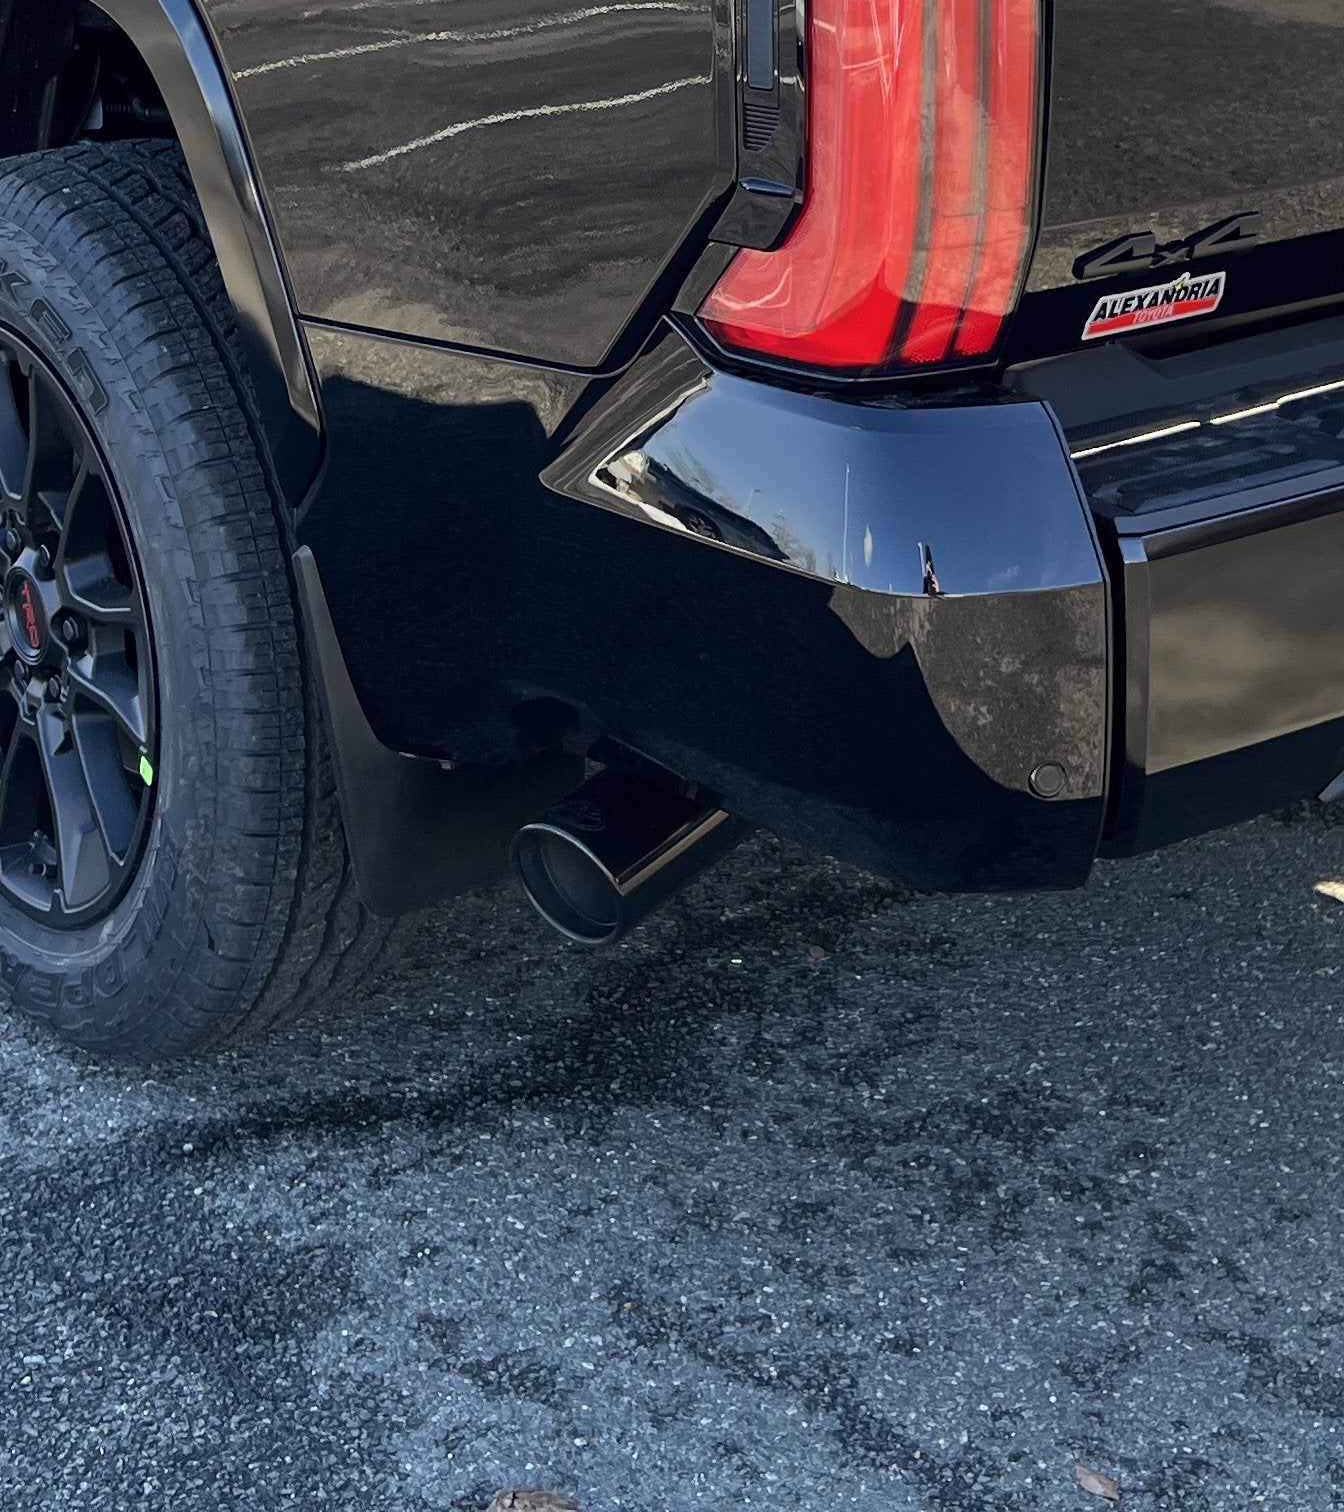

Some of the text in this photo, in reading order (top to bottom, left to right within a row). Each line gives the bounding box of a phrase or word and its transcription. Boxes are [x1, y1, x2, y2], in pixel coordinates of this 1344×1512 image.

[1090, 277, 1223, 324] ALEXANDRIA
[1132, 304, 1175, 325] TOYOTA
[20, 578, 41, 648] TRD
